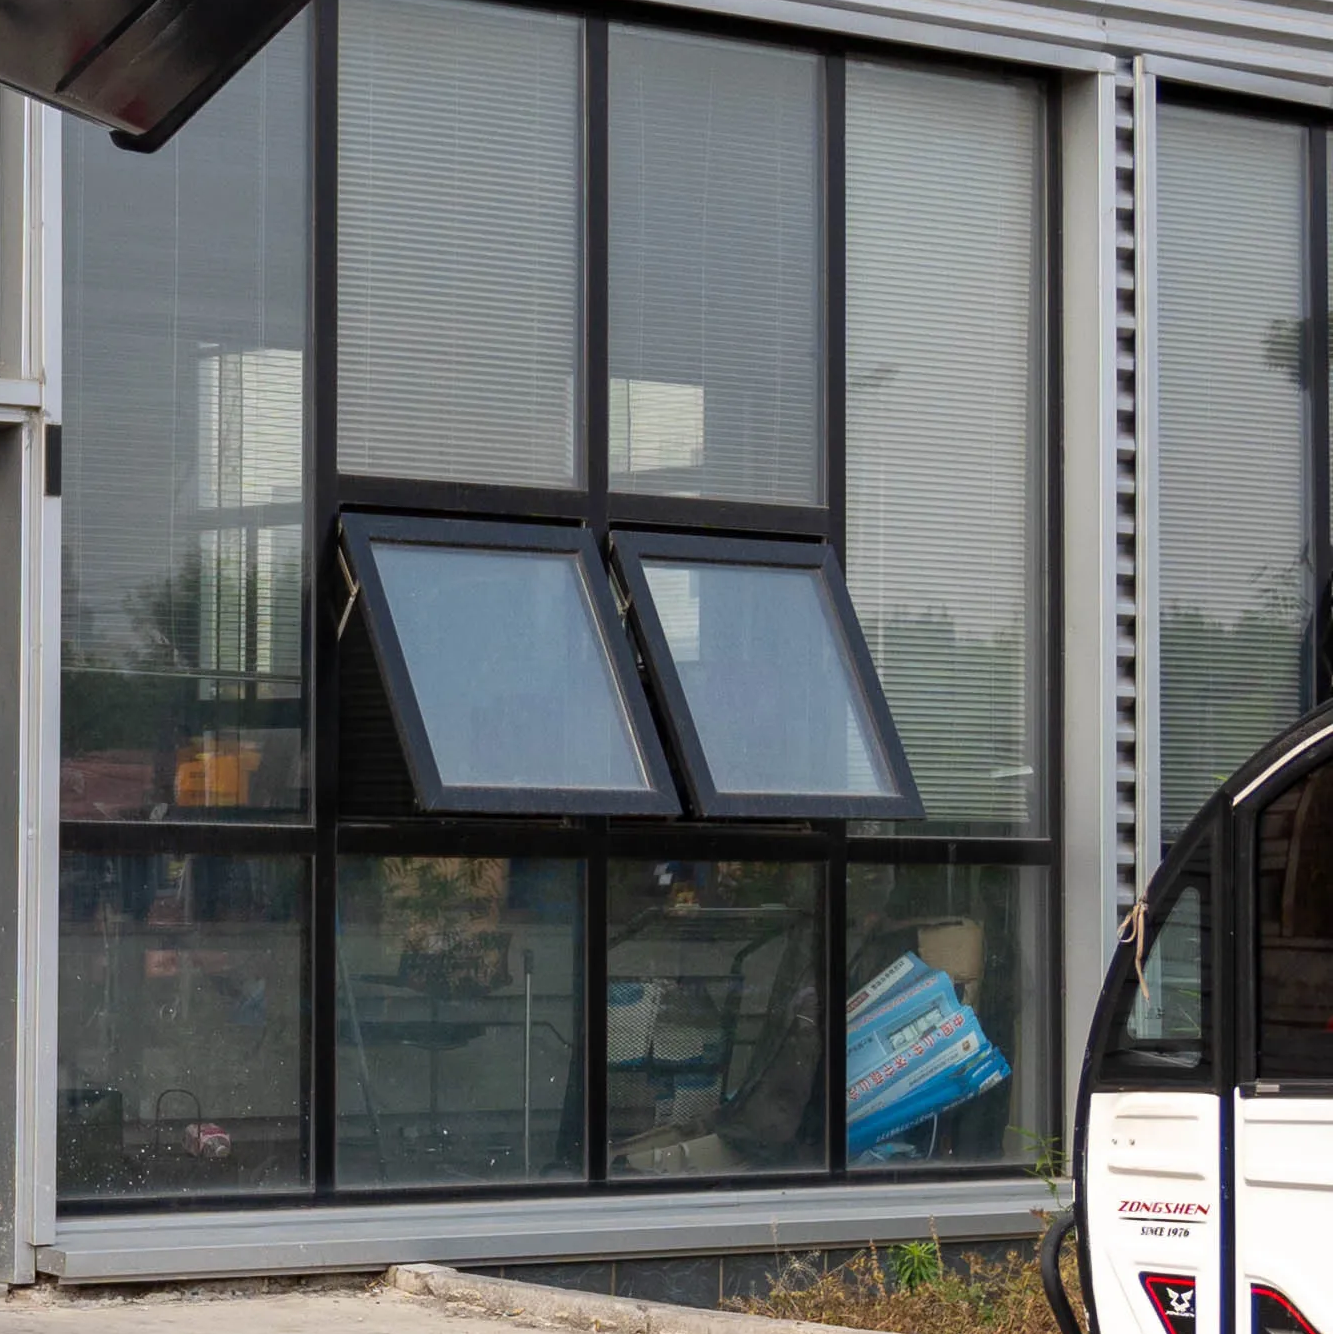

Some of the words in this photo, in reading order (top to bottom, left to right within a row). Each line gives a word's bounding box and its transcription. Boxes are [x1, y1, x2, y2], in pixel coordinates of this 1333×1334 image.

[1118, 1200, 1211, 1215] ZONGSHEN
[1140, 1226, 1165, 1237] SINCE
[1167, 1227, 1190, 1238] 1976
